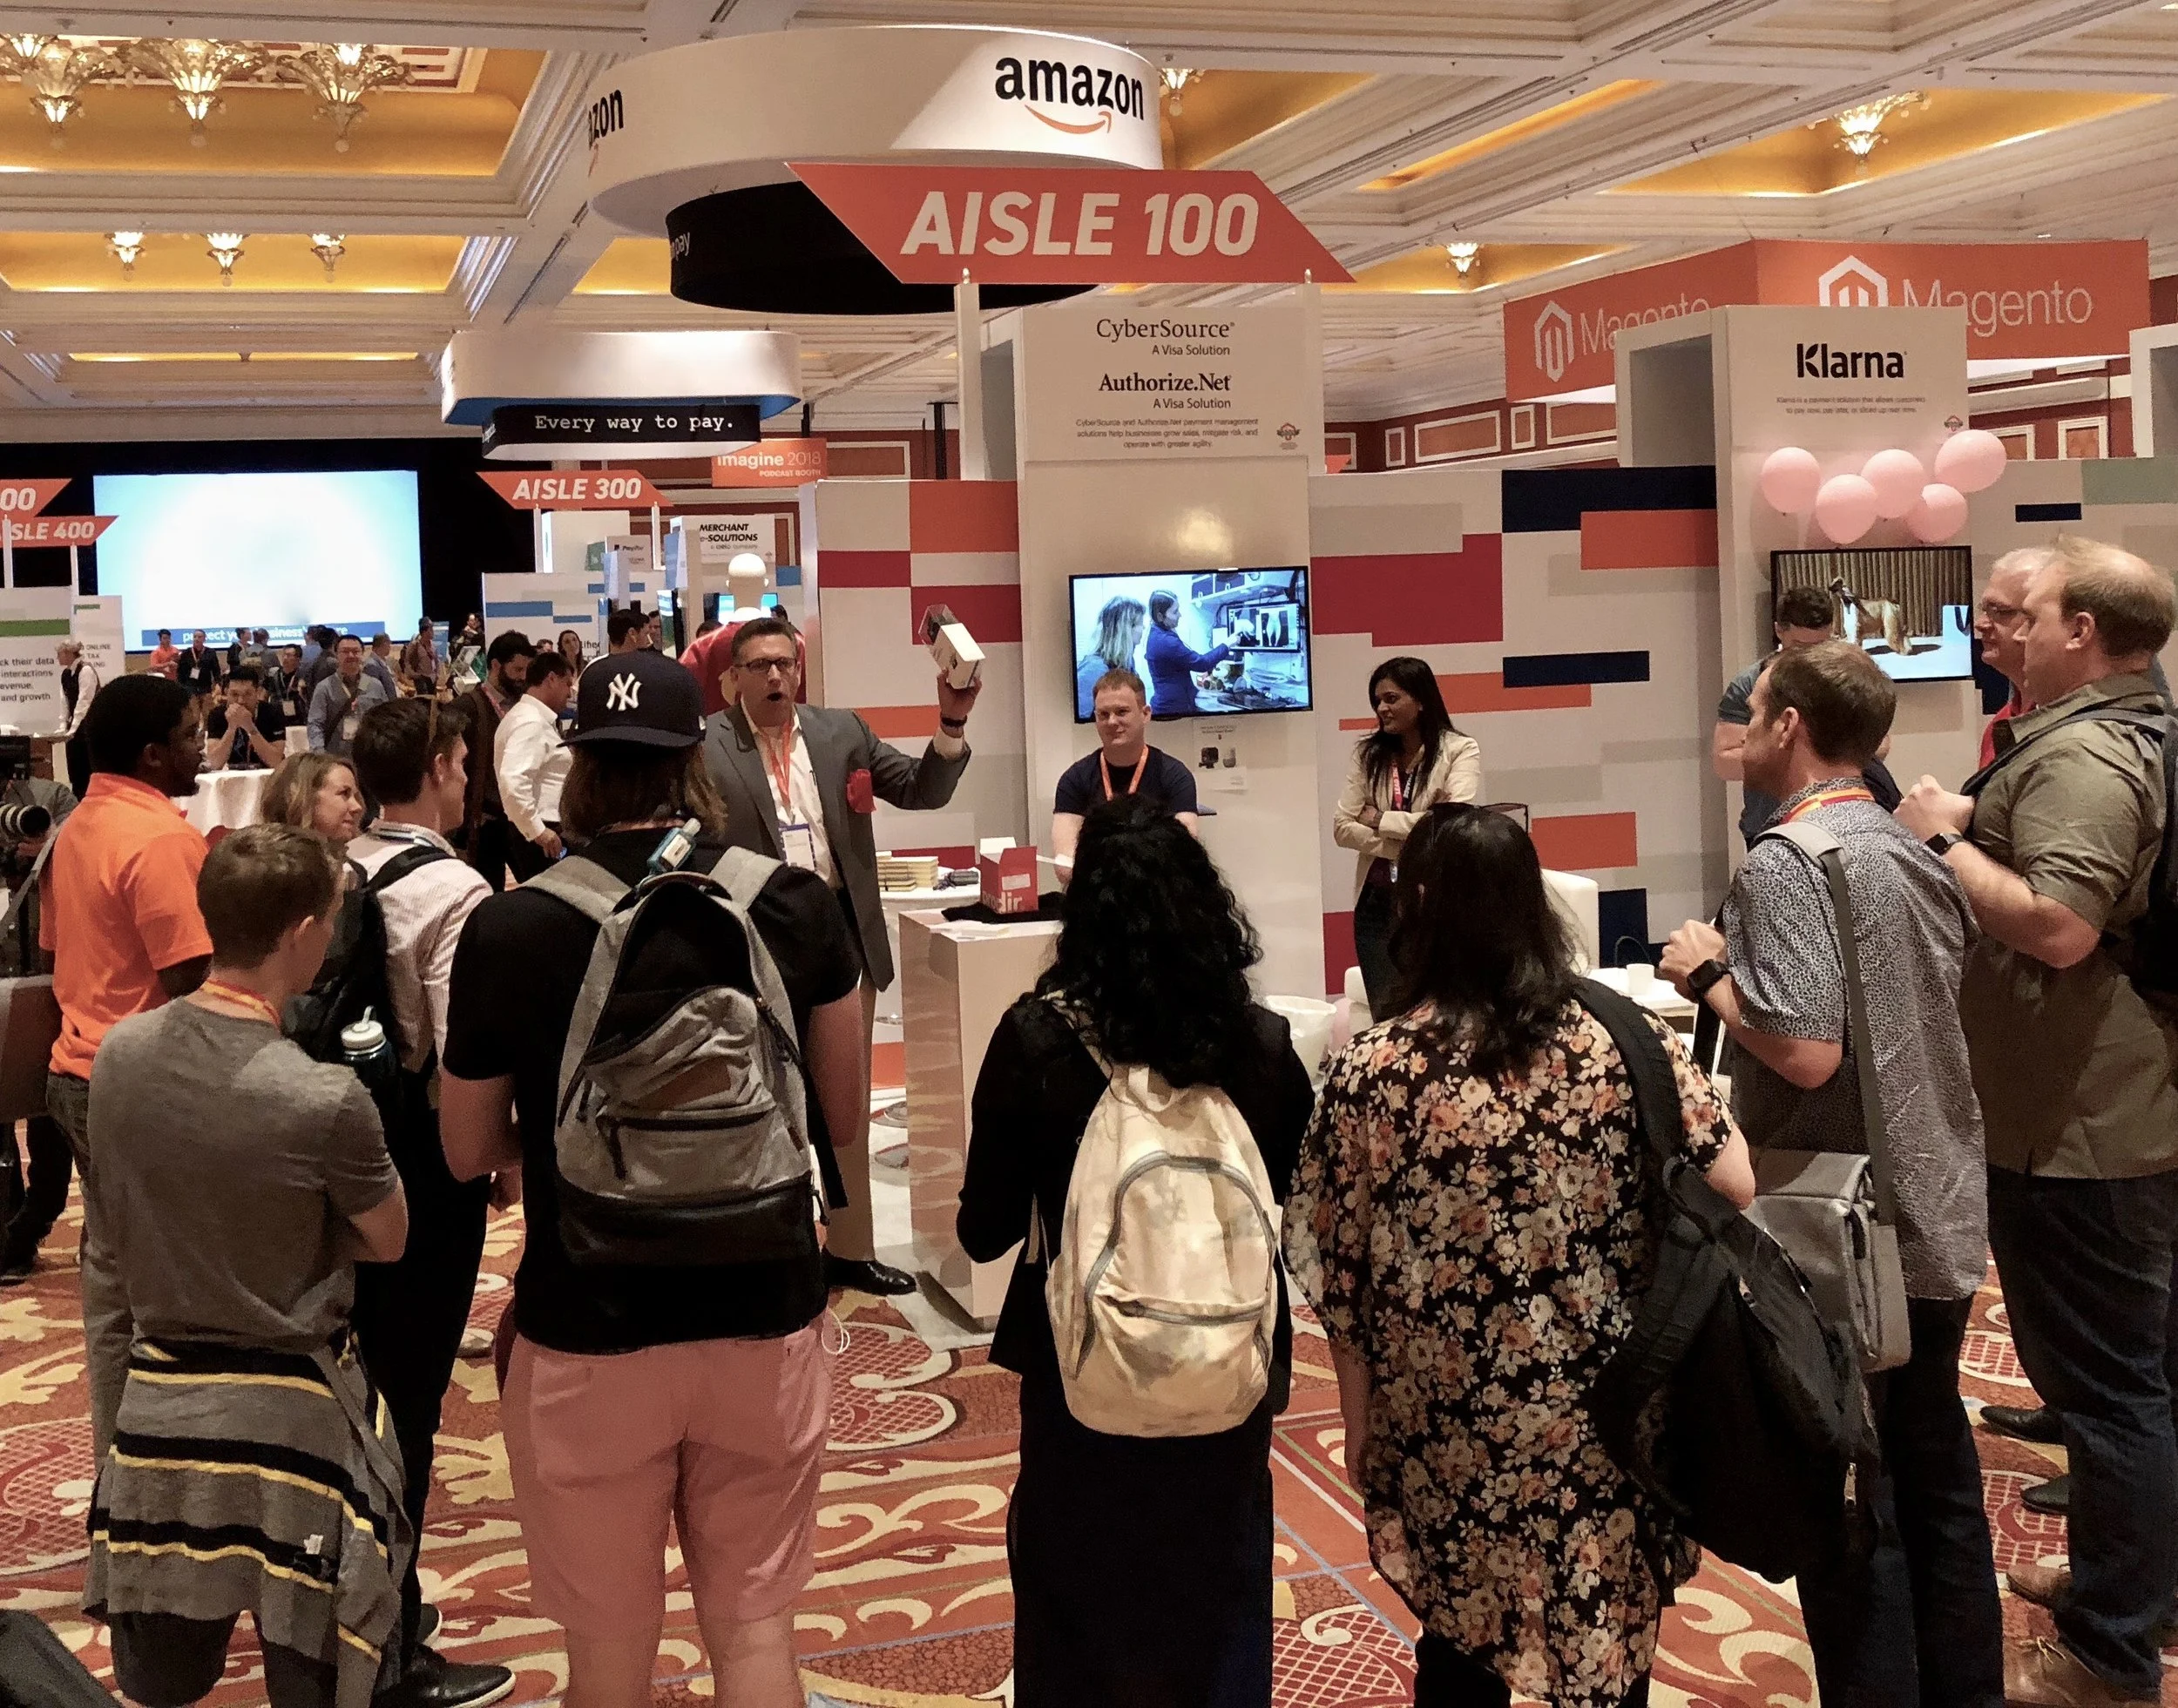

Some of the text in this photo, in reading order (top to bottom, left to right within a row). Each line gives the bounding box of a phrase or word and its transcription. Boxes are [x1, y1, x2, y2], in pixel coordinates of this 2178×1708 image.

[995, 57, 1145, 121] amazon
[900, 191, 1259, 257] AISLE 100
[1152, 345, 1230, 355] A Visa Solution
[1796, 343, 1904, 378] Klarna
[1099, 372, 1231, 392] Authorize.Net
[1153, 398, 1231, 408] A Visa Solution
[535, 415, 734, 432] Every way to pay.
[787, 452, 821, 466] 2018
[512, 478, 641, 500] AISLE 300
[0, 488, 37, 511] 00
[11, 522, 95, 541] SLE 400
[19, 693, 51, 704] growth
